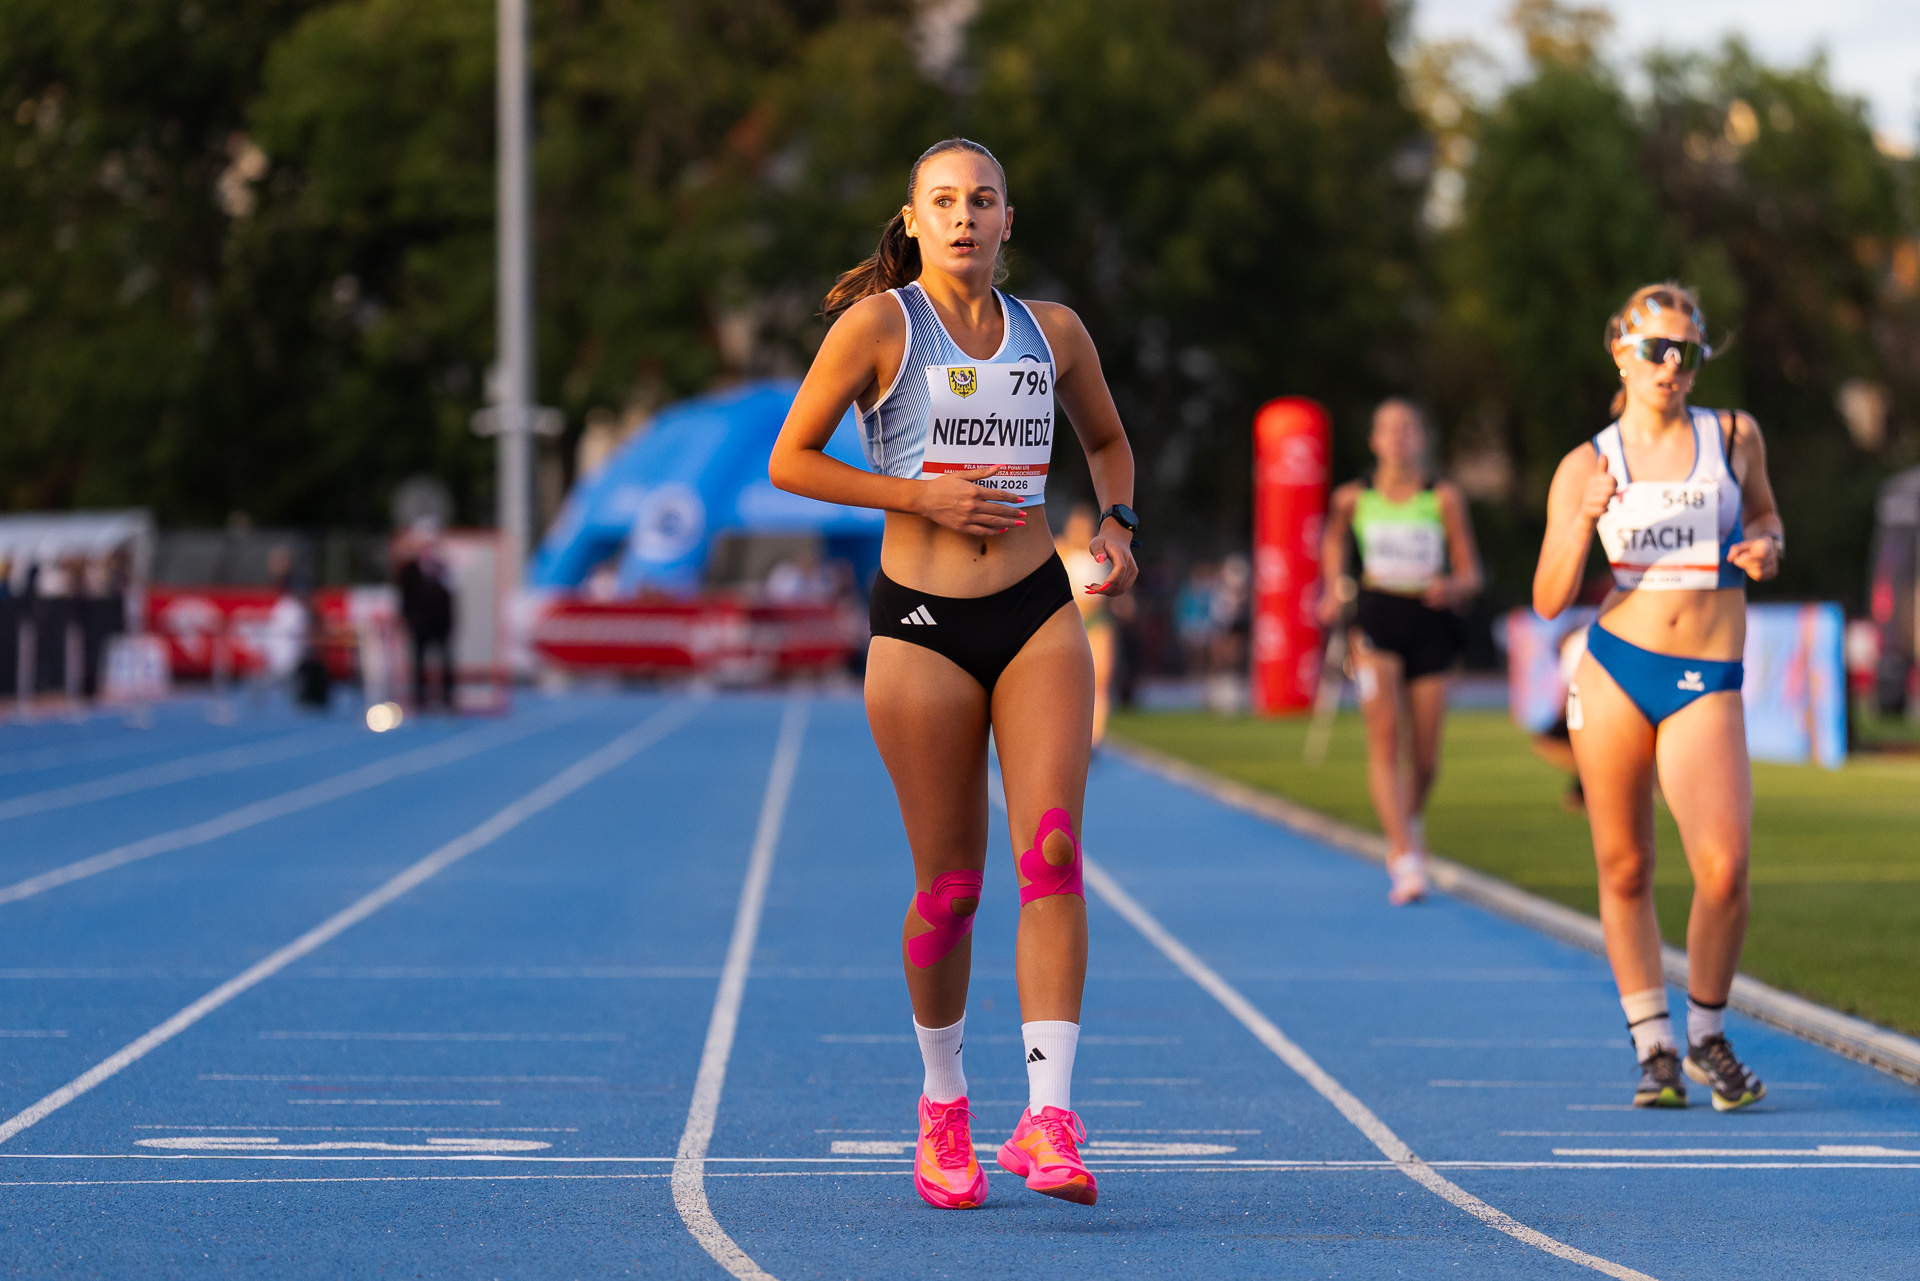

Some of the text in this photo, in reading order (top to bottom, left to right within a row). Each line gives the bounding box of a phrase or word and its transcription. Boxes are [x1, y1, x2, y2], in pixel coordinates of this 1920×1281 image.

[1009, 371, 1047, 395] 796
[932, 412, 1051, 447] NIEDŹWIEDŹ
[1001, 480, 1028, 489] 2026
[1662, 490, 1705, 509] 548
[1617, 526, 1694, 550] STACH
